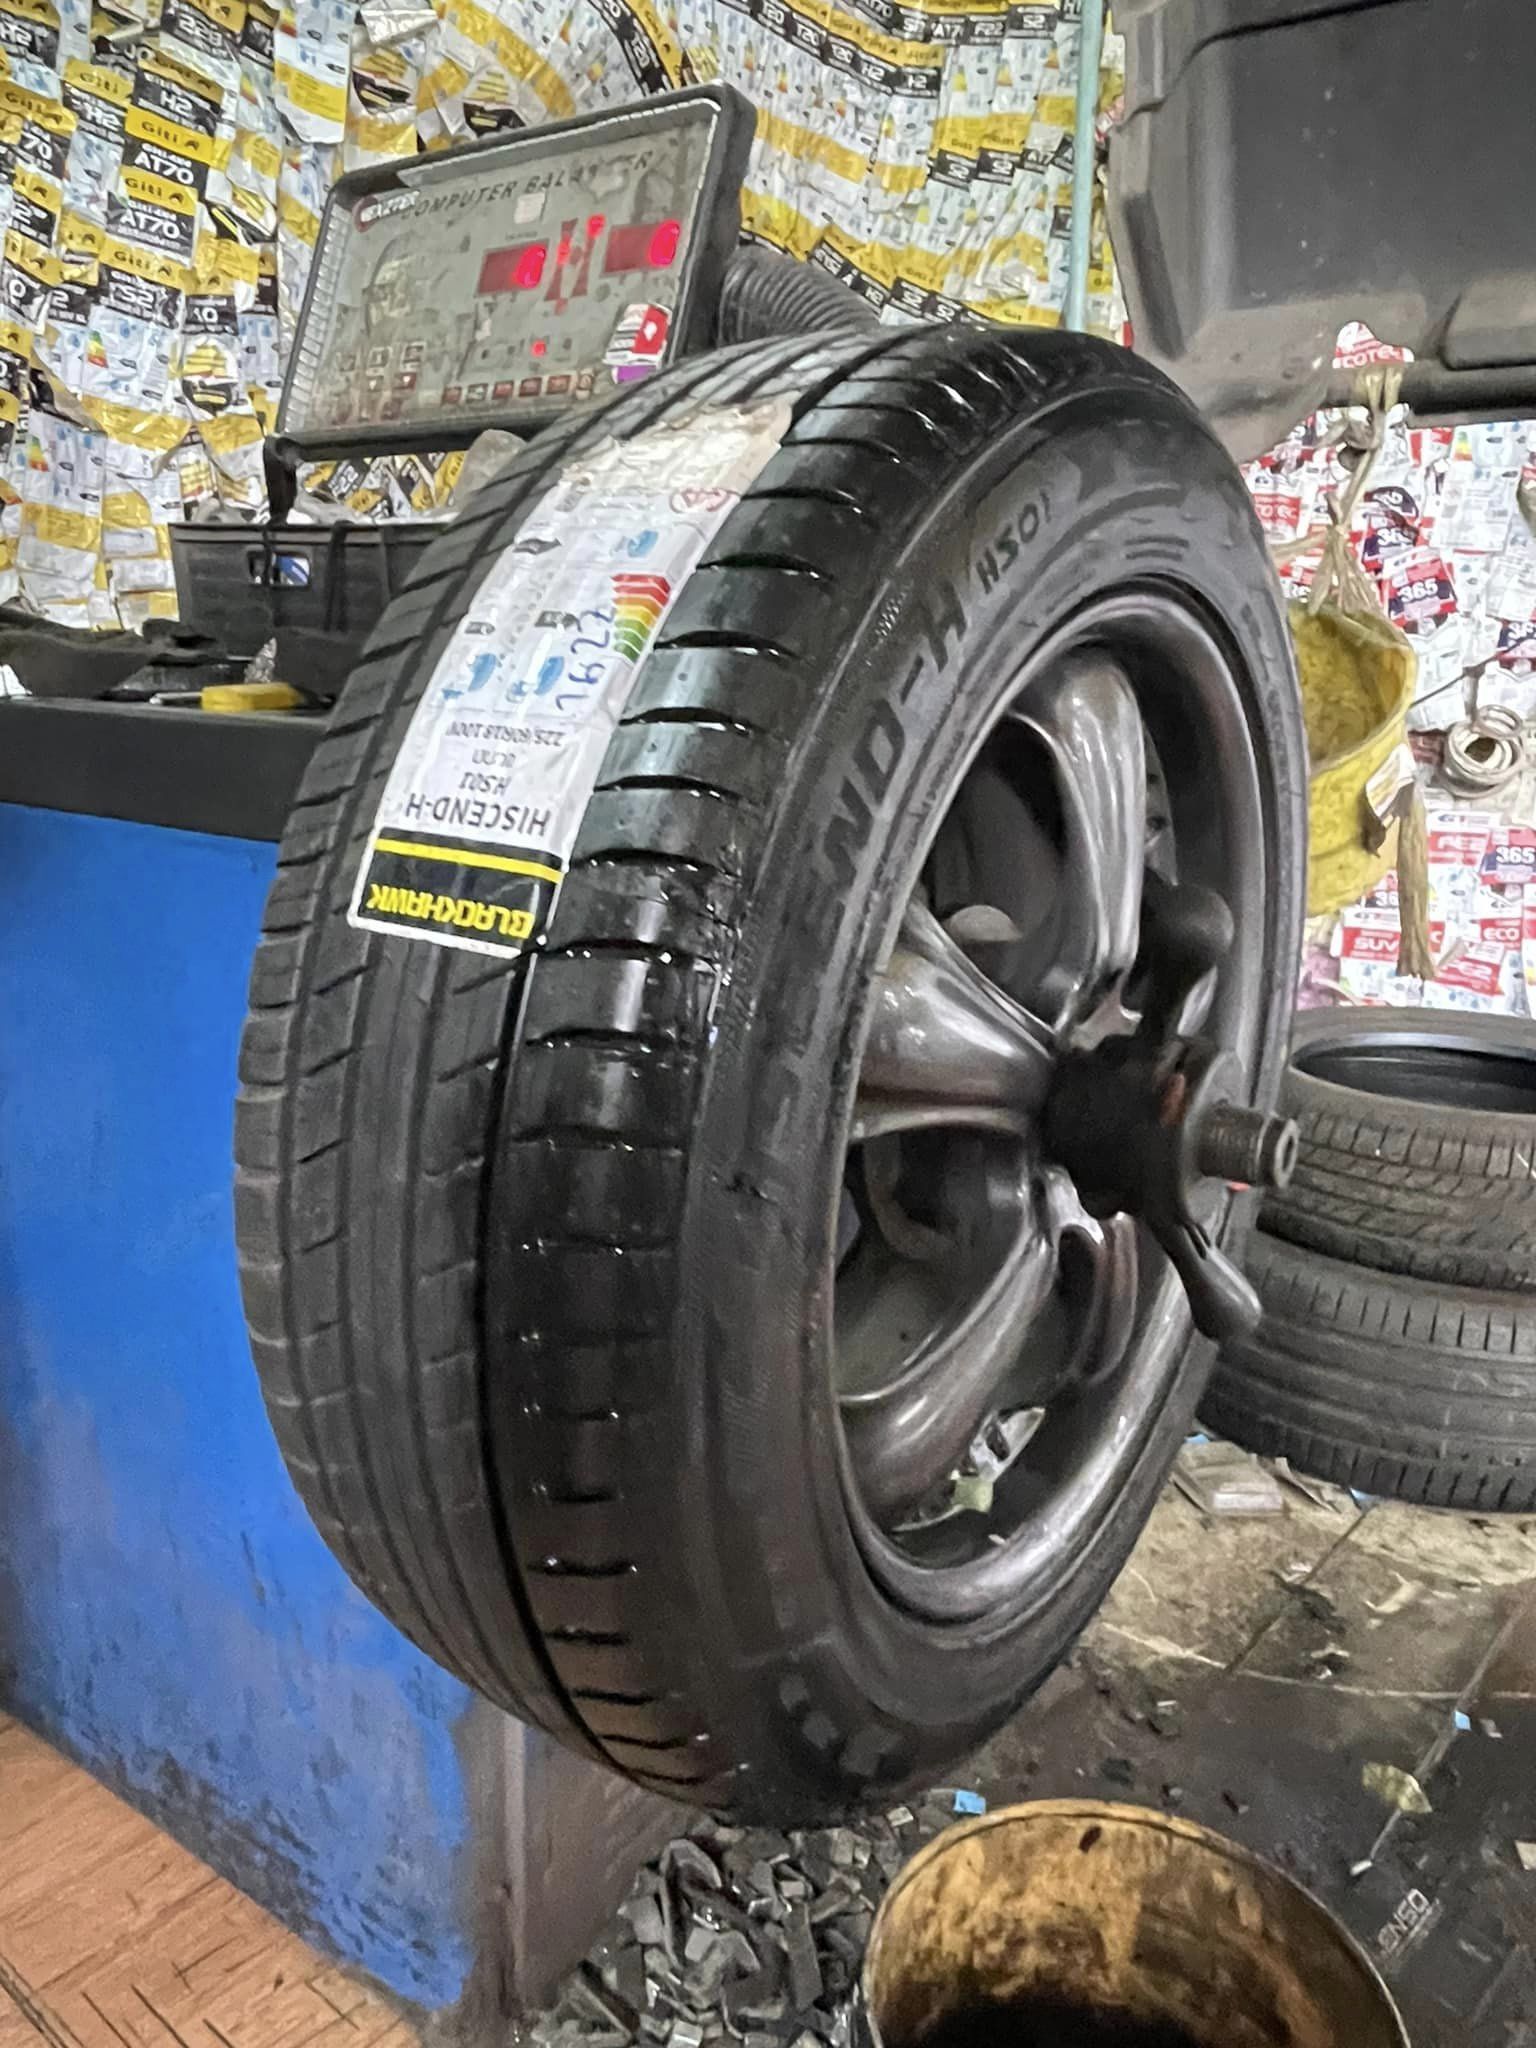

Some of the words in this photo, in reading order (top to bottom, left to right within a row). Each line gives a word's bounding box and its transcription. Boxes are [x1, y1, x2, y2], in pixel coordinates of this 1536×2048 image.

[141, 120, 178, 143] Giti
[134, 151, 194, 185] AT70
[124, 177, 162, 197] Giti
[120, 207, 180, 239] AT70
[1397, 577, 1440, 603] 365
[405, 793, 551, 837] HISCEND-H
[1495, 845, 1536, 864] 365
[365, 882, 536, 940] BLACKHAWK
[1375, 890, 1399, 908] 36
[1353, 937, 1399, 952] SUV
